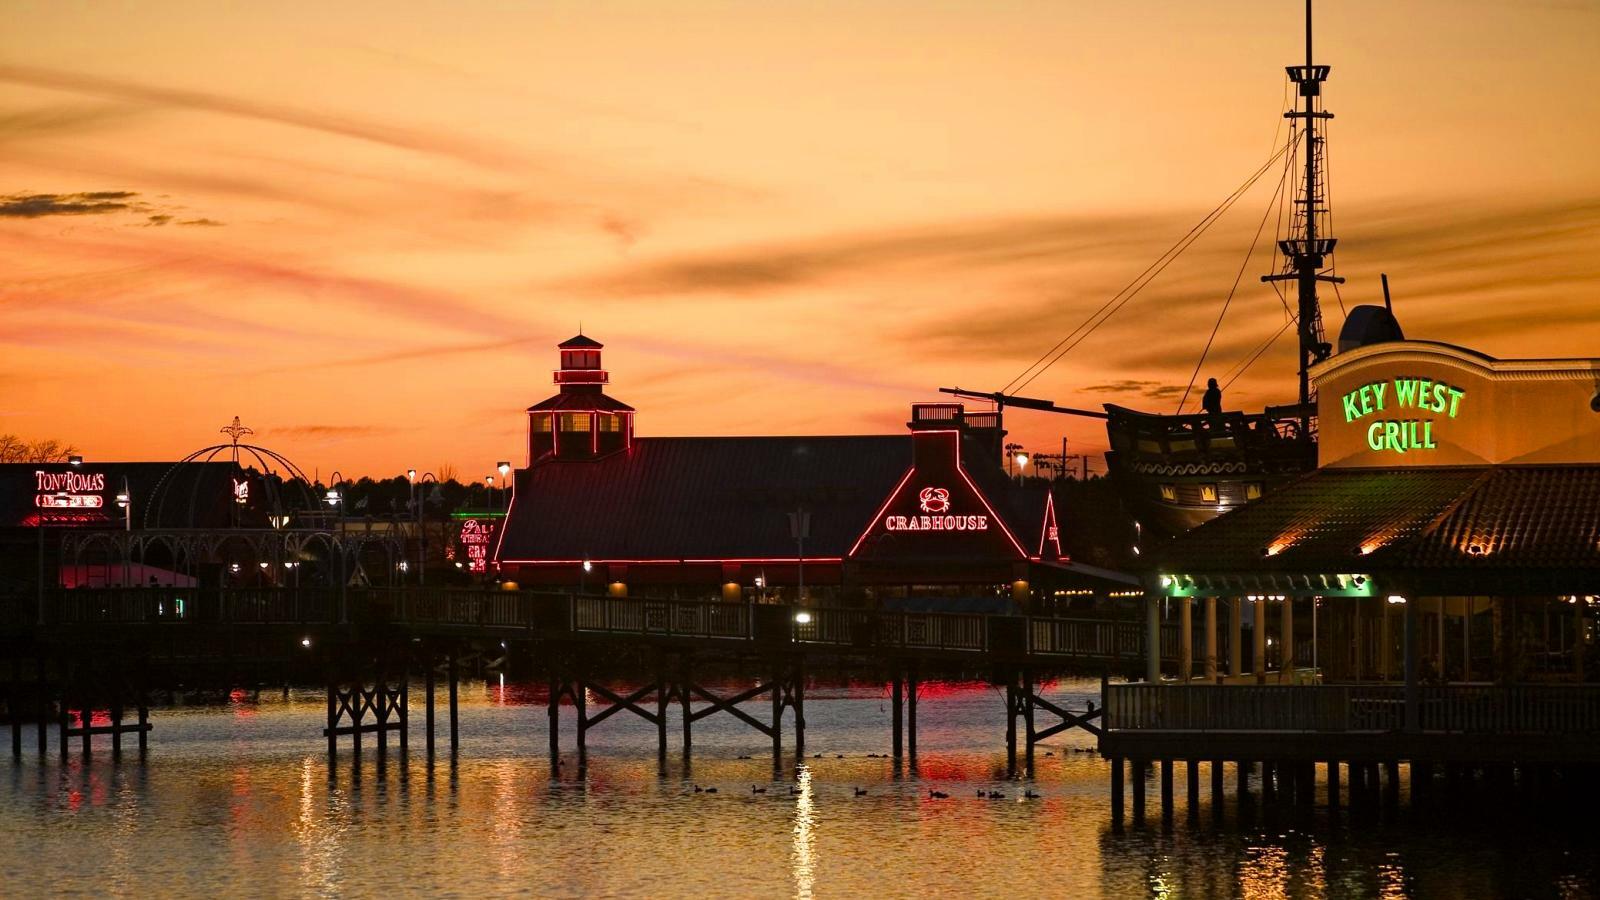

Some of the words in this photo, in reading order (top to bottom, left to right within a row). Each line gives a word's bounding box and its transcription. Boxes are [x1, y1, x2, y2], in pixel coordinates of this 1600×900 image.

[1342, 382, 1388, 423] KEY
[1394, 379, 1465, 418] WEST
[1367, 421, 1436, 453] GRILL
[885, 515, 988, 531] CRABHOUSE
